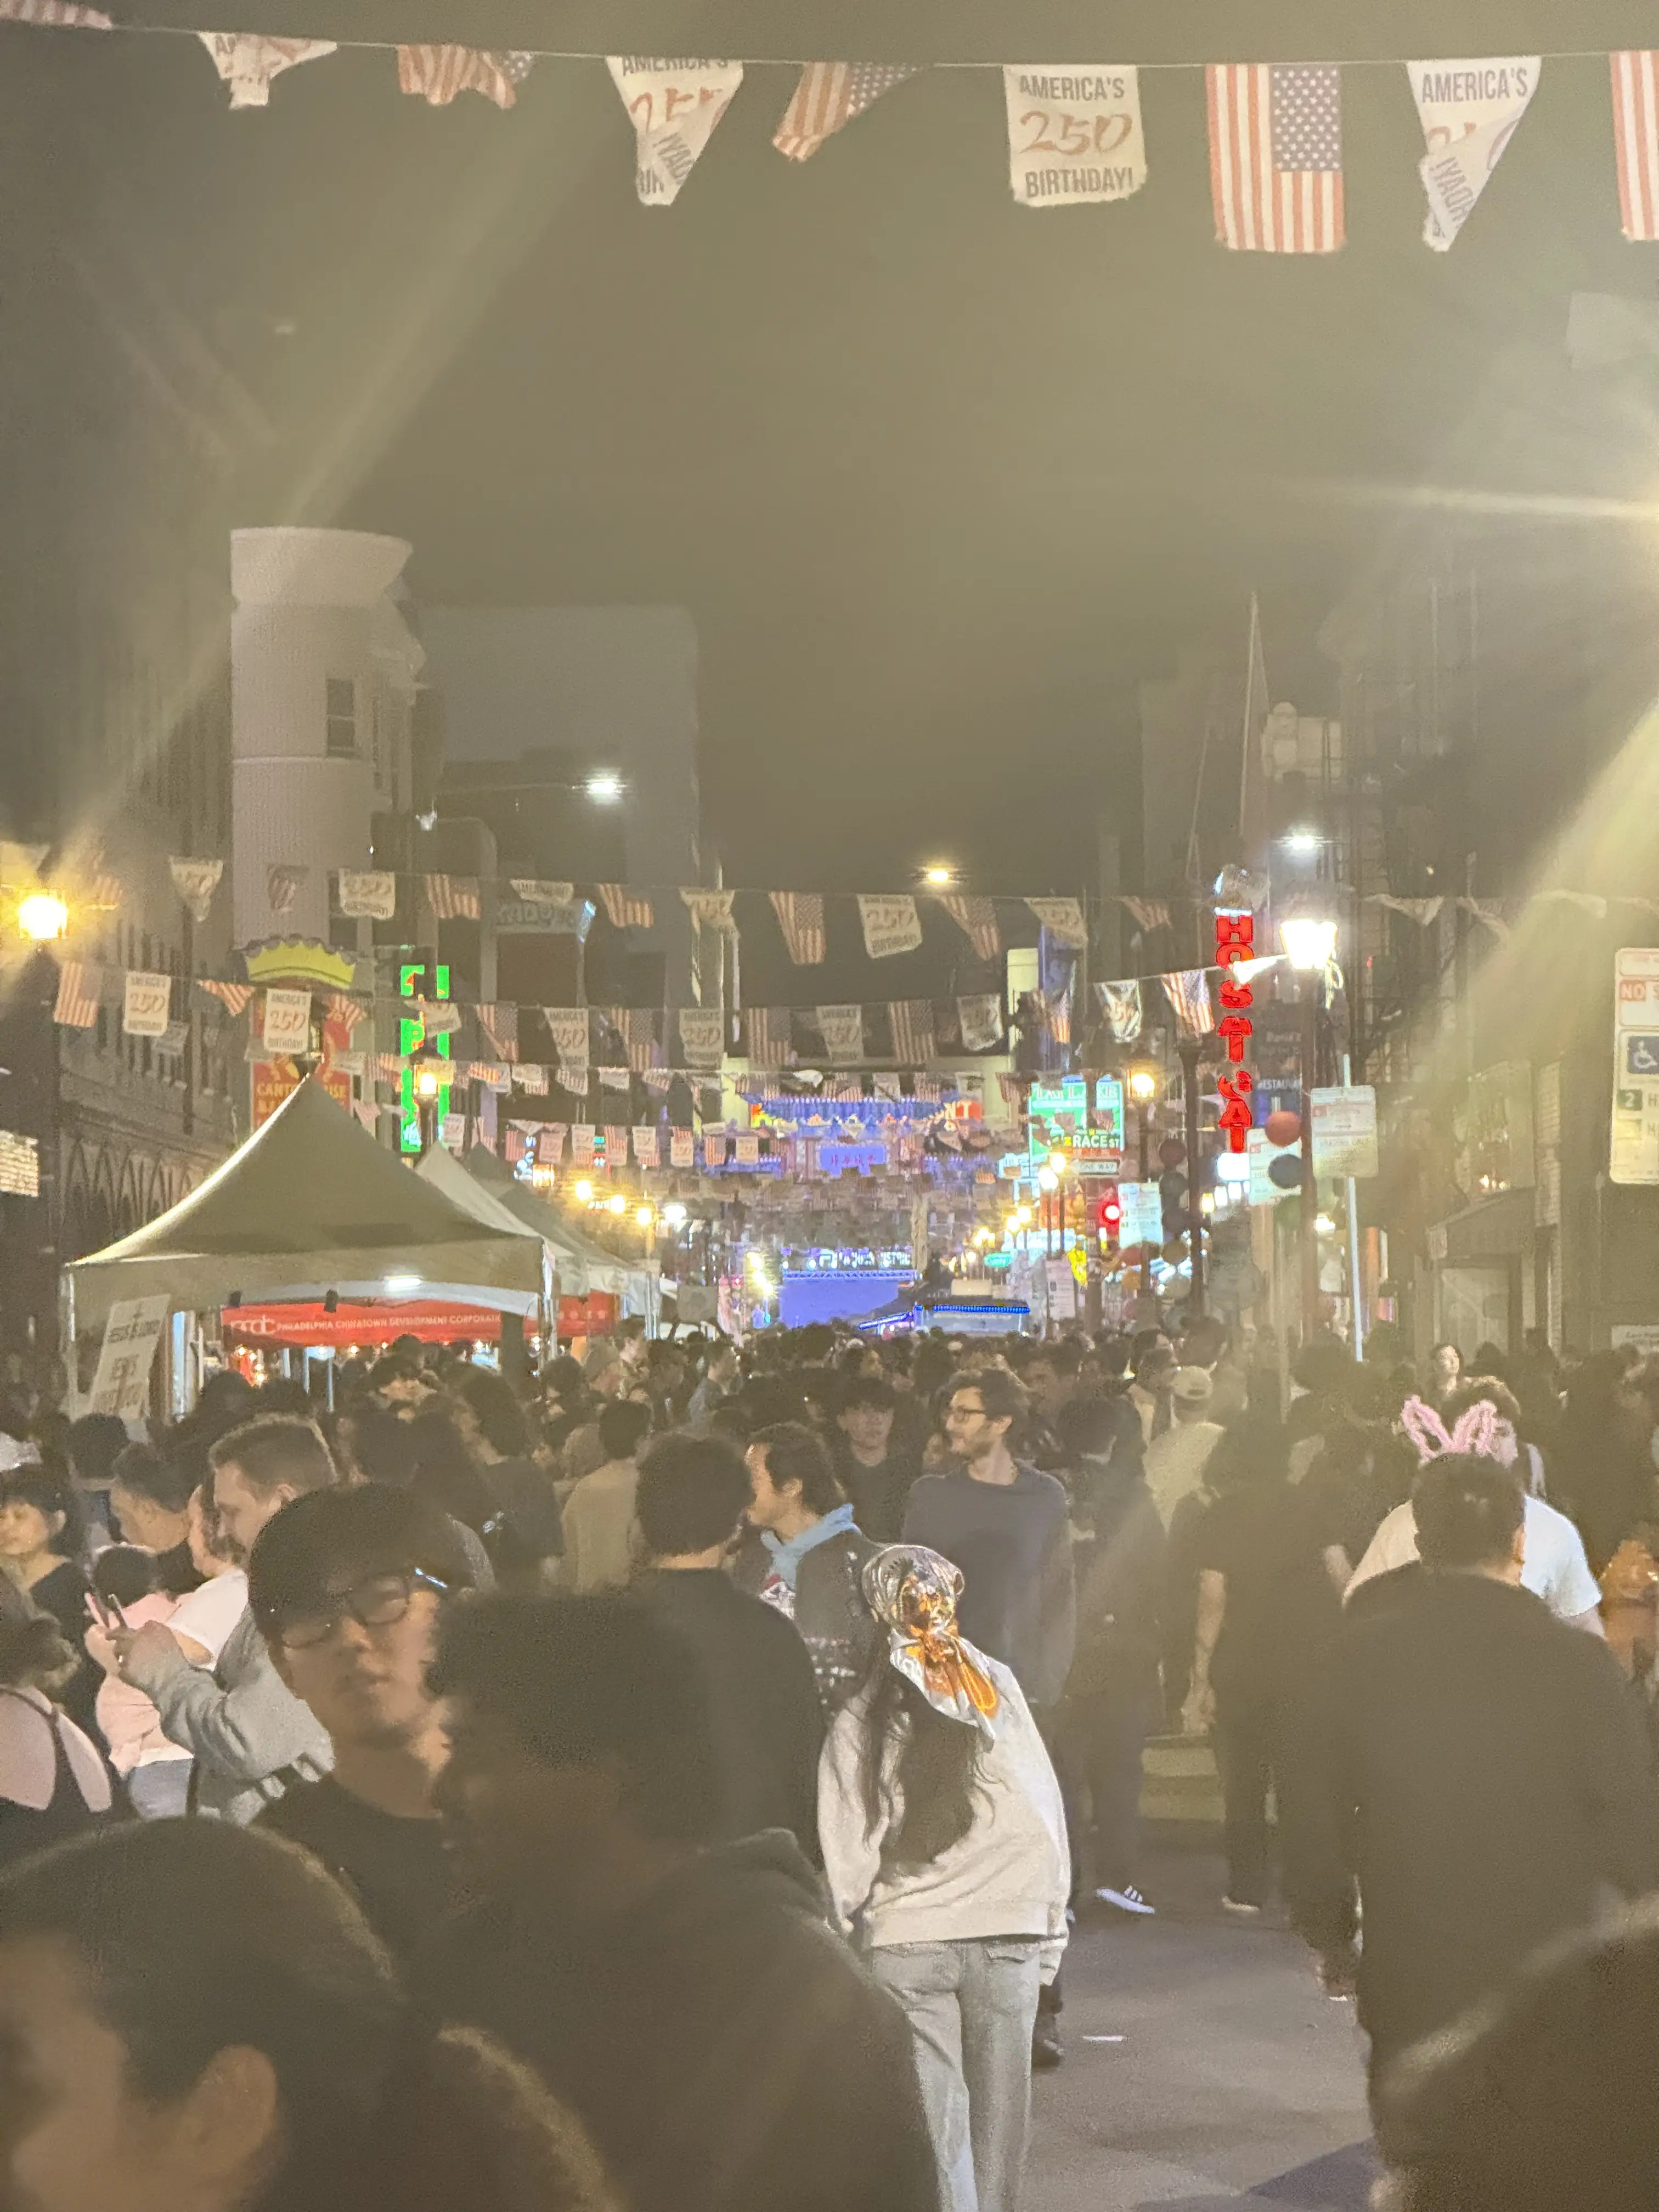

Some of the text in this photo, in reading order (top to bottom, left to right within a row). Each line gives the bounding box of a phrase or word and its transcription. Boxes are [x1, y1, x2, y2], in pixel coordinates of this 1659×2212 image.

[1019, 75, 1125, 101] AMERICA'S
[1422, 67, 1528, 103] AMERICA'S
[1018, 110, 1133, 156] 250
[1025, 167, 1133, 198] BIRTHDAY!
[1621, 983, 1646, 999] NO
[129, 993, 165, 1013] 250
[269, 1009, 306, 1031] 250
[1624, 1091, 1635, 1108] 2
[1073, 1135, 1120, 1148] RACE ST
[276, 1321, 334, 1331] PHILADELPHIA
[335, 1319, 387, 1329] CHINATOWN
[388, 1316, 447, 1327] DEVELOPMENT
[449, 1313, 501, 1324] CORPORATI
